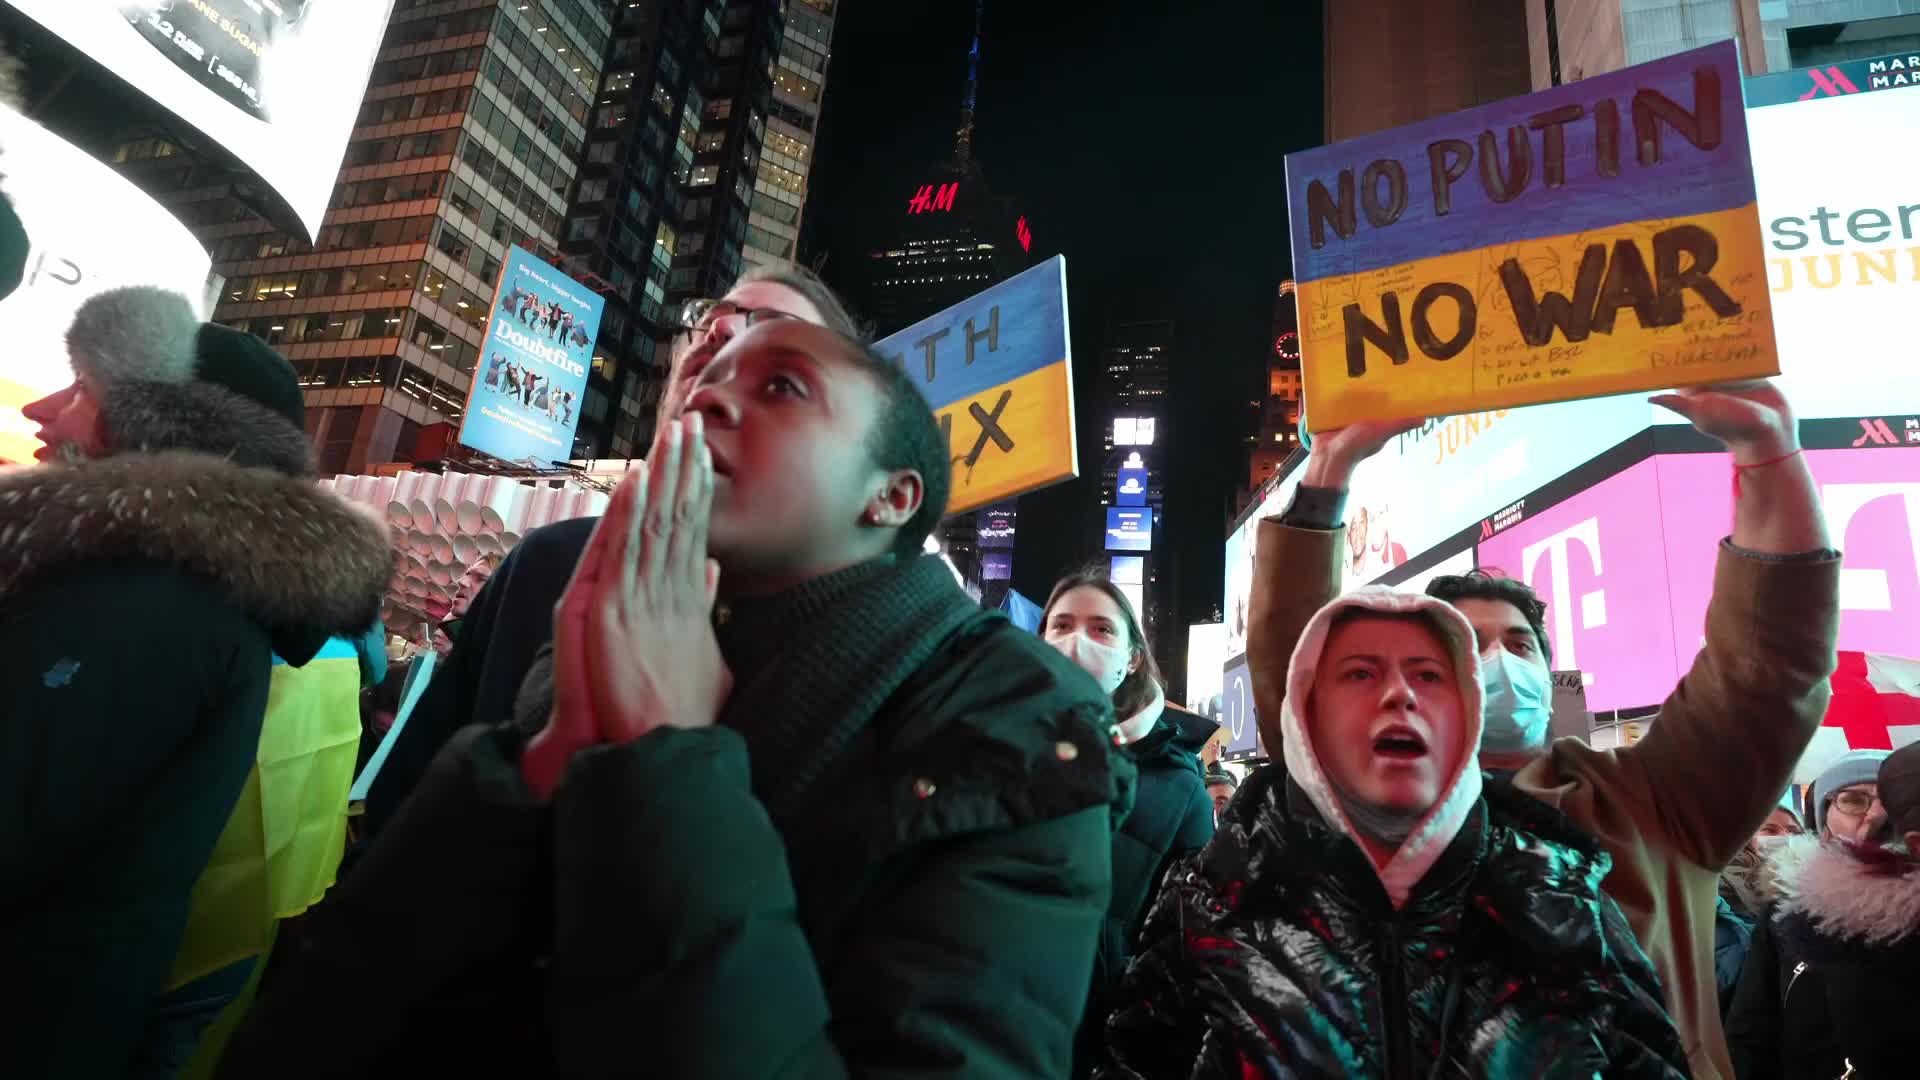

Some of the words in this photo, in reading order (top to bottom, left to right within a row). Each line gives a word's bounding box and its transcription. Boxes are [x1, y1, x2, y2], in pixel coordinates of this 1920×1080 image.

[1307, 158, 1409, 250] NO
[1428, 65, 1722, 216] PUTIN
[908, 182, 959, 215] H&M
[1343, 281, 1479, 378] NO
[1500, 224, 1744, 347] WAR
[496, 320, 585, 378] Doubtfire
[1494, 500, 1525, 522] MARRIOTT
[1494, 511, 1522, 532] MARQUIS
